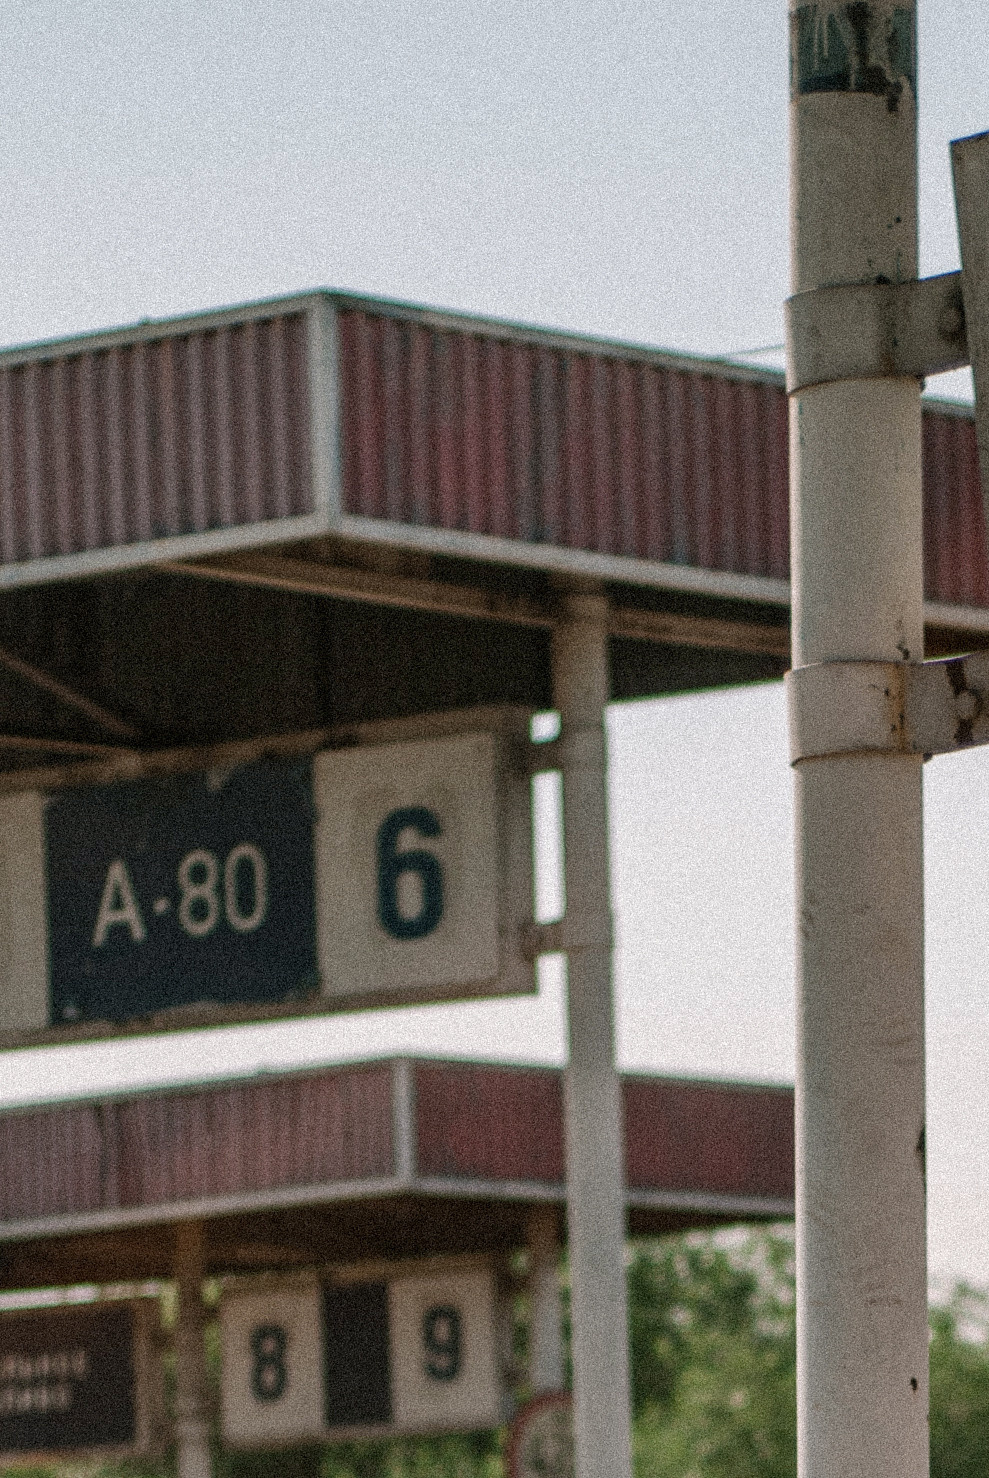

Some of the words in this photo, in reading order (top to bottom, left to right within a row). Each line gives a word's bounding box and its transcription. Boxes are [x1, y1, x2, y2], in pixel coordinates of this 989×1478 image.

[376, 807, 444, 940] 6
[249, 1322, 289, 1403] 8
[422, 1302, 462, 1382] 9
